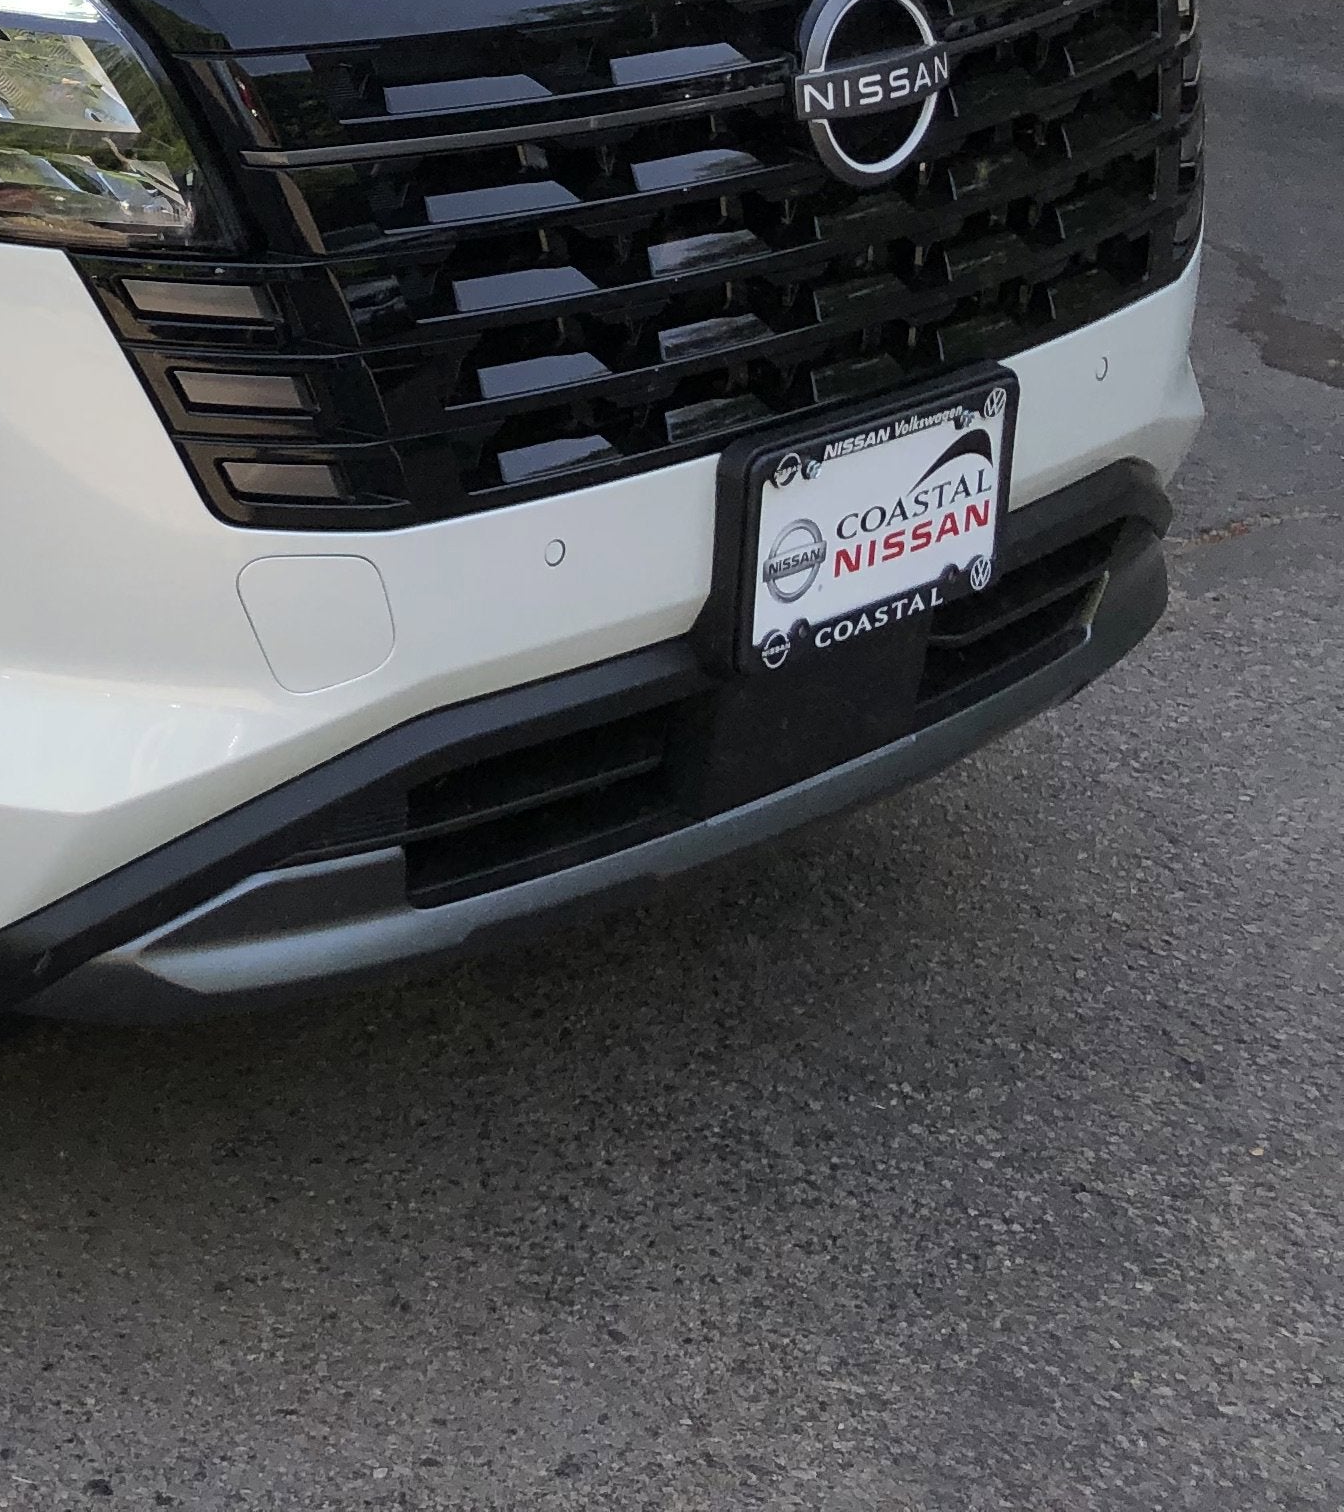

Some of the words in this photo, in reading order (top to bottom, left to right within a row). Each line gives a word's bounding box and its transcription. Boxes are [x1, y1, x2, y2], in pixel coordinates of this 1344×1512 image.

[803, 51, 949, 113] NISSAN
[823, 426, 891, 461] NISSAN
[894, 405, 963, 437] Volkswagen
[835, 468, 993, 540] COASTAL
[768, 548, 820, 576] NISSAN
[833, 499, 991, 579] NISSAN
[814, 587, 944, 648] COASTAL
